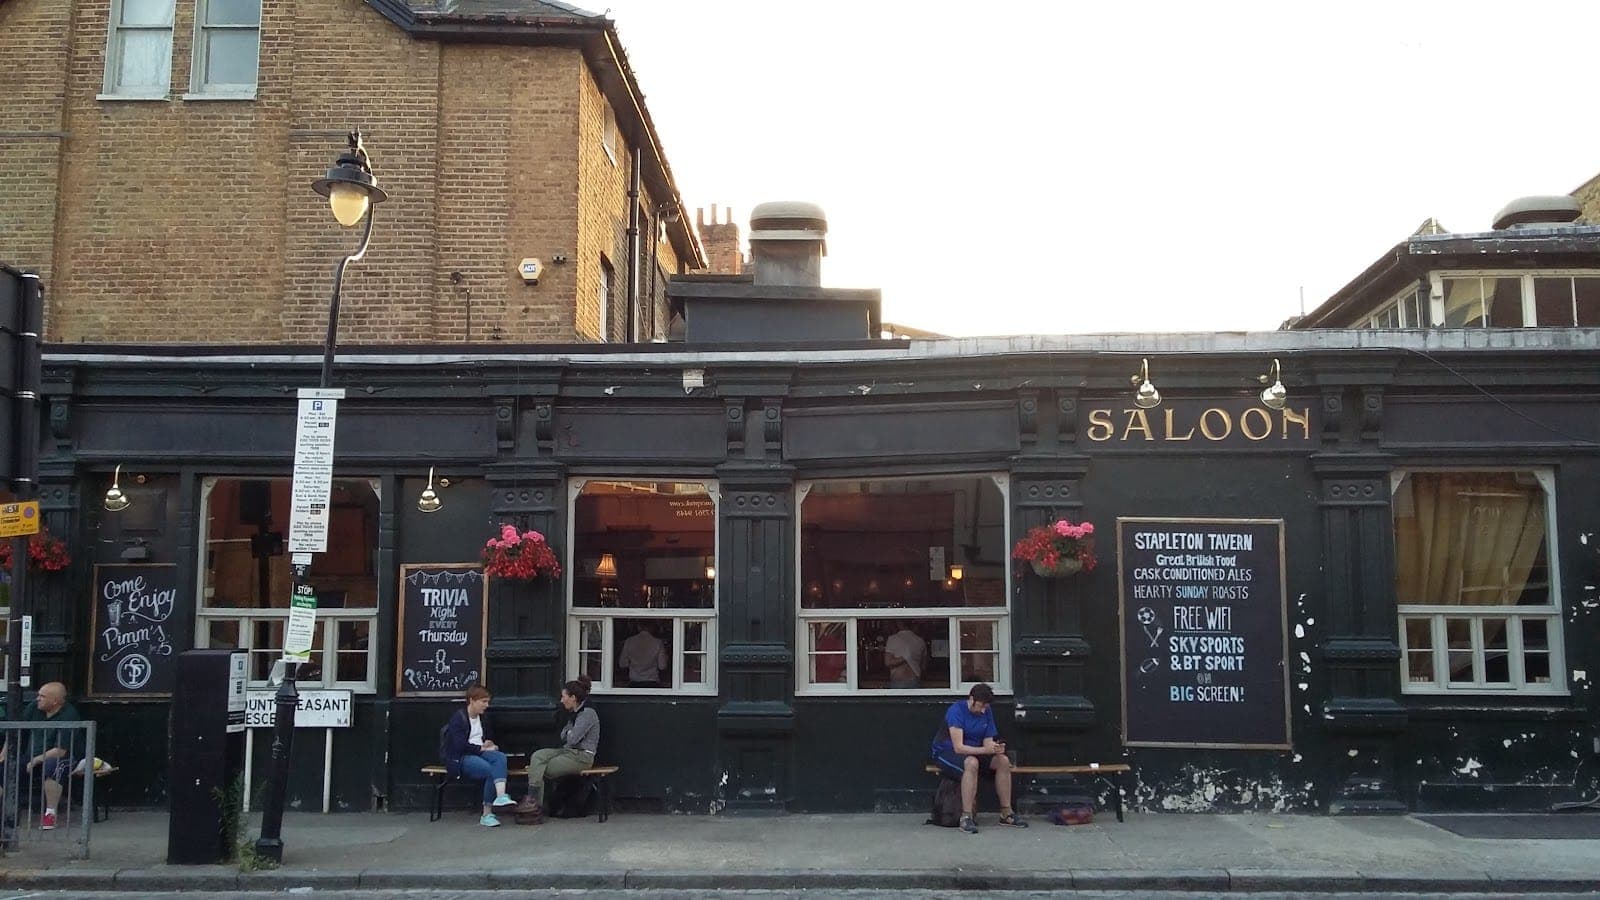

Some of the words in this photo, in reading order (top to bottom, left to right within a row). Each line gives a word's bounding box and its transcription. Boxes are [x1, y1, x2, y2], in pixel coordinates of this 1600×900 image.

[1087, 408, 1309, 441] SALOON
[1135, 532, 1202, 550] STAPLETON
[1208, 534, 1252, 551] TAVERN
[1156, 554, 1185, 566] Great
[1186, 554, 1214, 566] British
[1215, 555, 1236, 567] Food
[1134, 568, 1161, 580] CASK
[1162, 568, 1225, 581] CONDITIONED
[1228, 569, 1252, 582] ALES
[104, 576, 146, 600] Come
[1134, 585, 1172, 599] HEARTY
[1176, 586, 1208, 599] SUNDAY
[1212, 586, 1249, 600] ROASTS
[129, 588, 176, 617] Enjoy
[421, 588, 469, 606] TRIVIA
[430, 607, 457, 620] Night
[1174, 606, 1203, 630] FREE
[1205, 606, 1231, 630] WIFI
[102, 625, 166, 650] Pimm's
[419, 630, 468, 646] Thursday
[1169, 636, 1198, 653] SKY
[1200, 637, 1244, 654] SPORTS
[1205, 656, 1244, 671] SPORT
[1170, 686, 1194, 702] BIG
[1197, 686, 1244, 702] SCREEN!
[245, 699, 274, 711] UNT
[296, 699, 348, 710] EASANT
